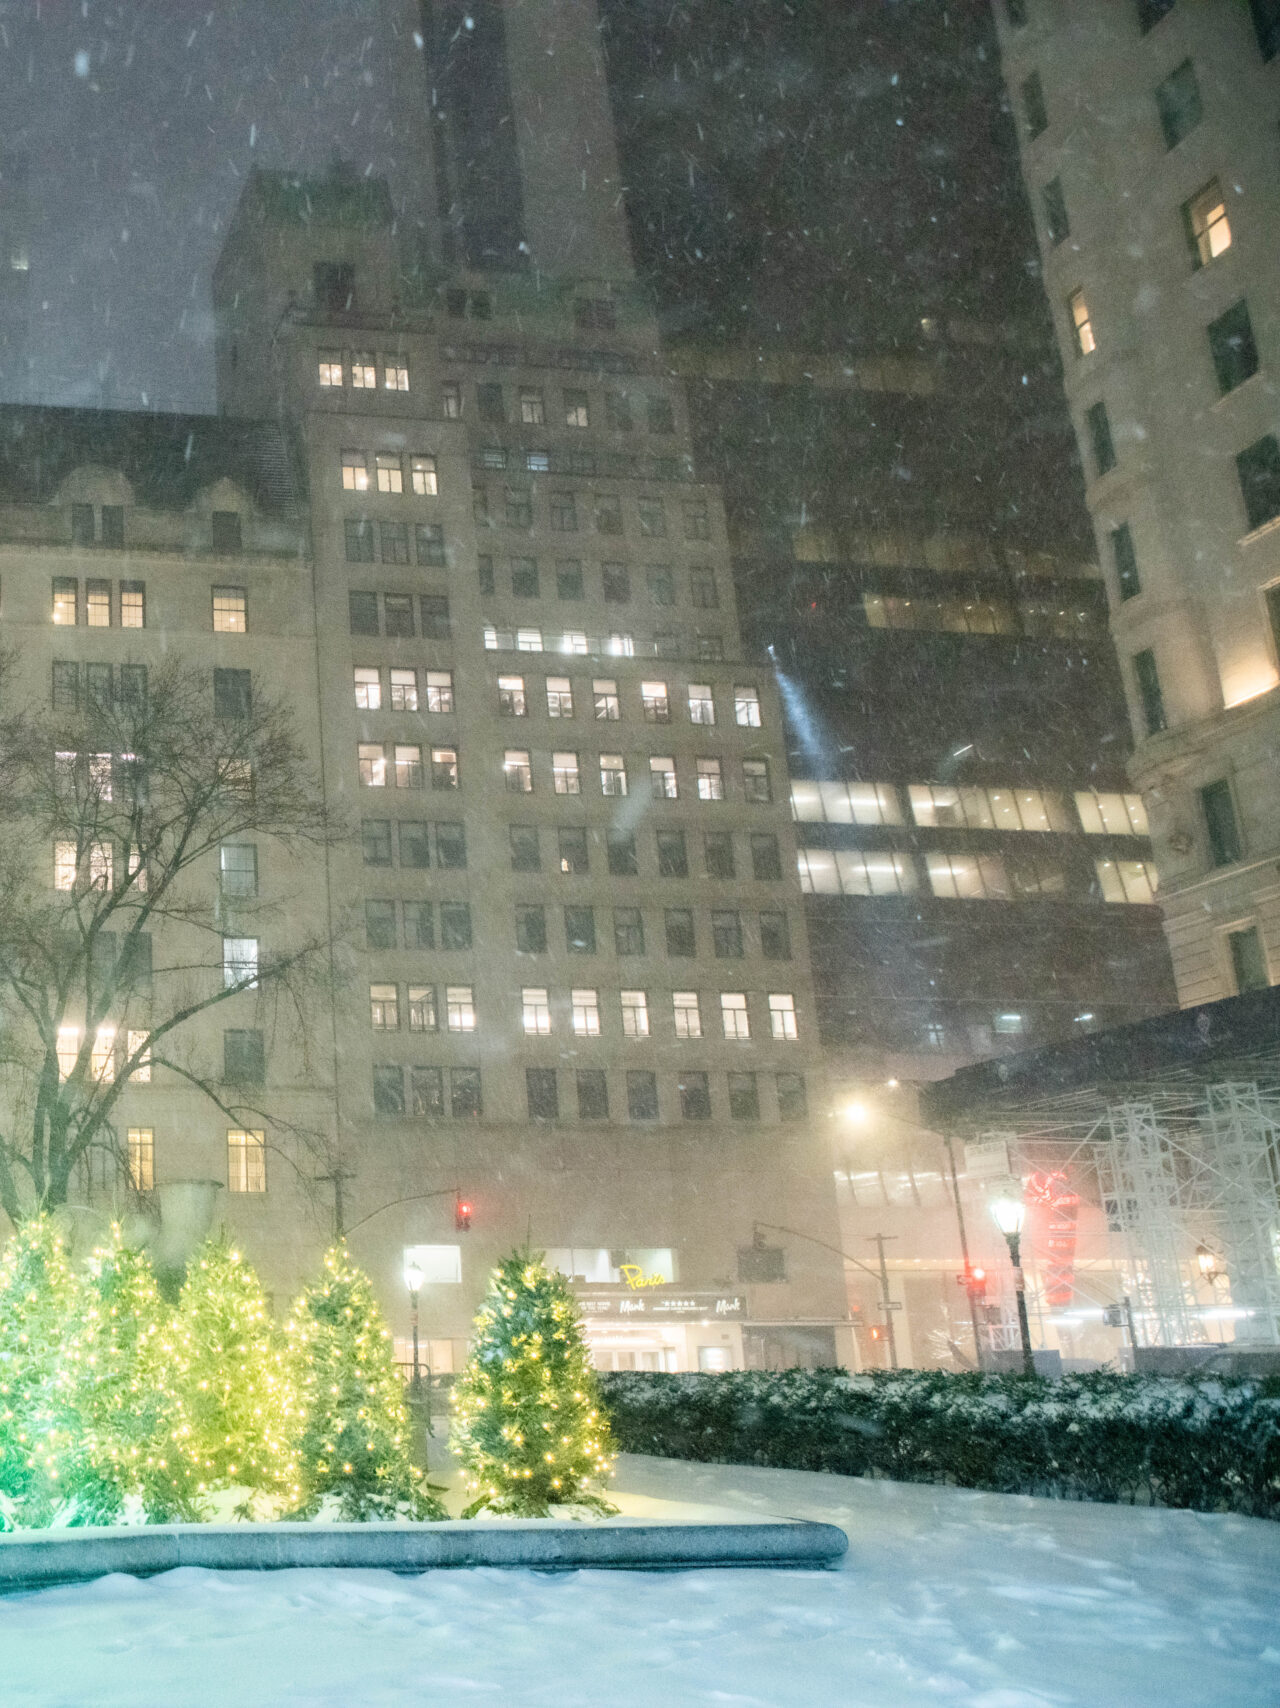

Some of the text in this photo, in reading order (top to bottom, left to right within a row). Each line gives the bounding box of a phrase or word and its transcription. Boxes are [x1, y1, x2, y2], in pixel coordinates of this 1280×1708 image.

[619, 1264, 666, 1290] Paris
[619, 1298, 646, 1316] Mank
[715, 1297, 741, 1316] Mank
